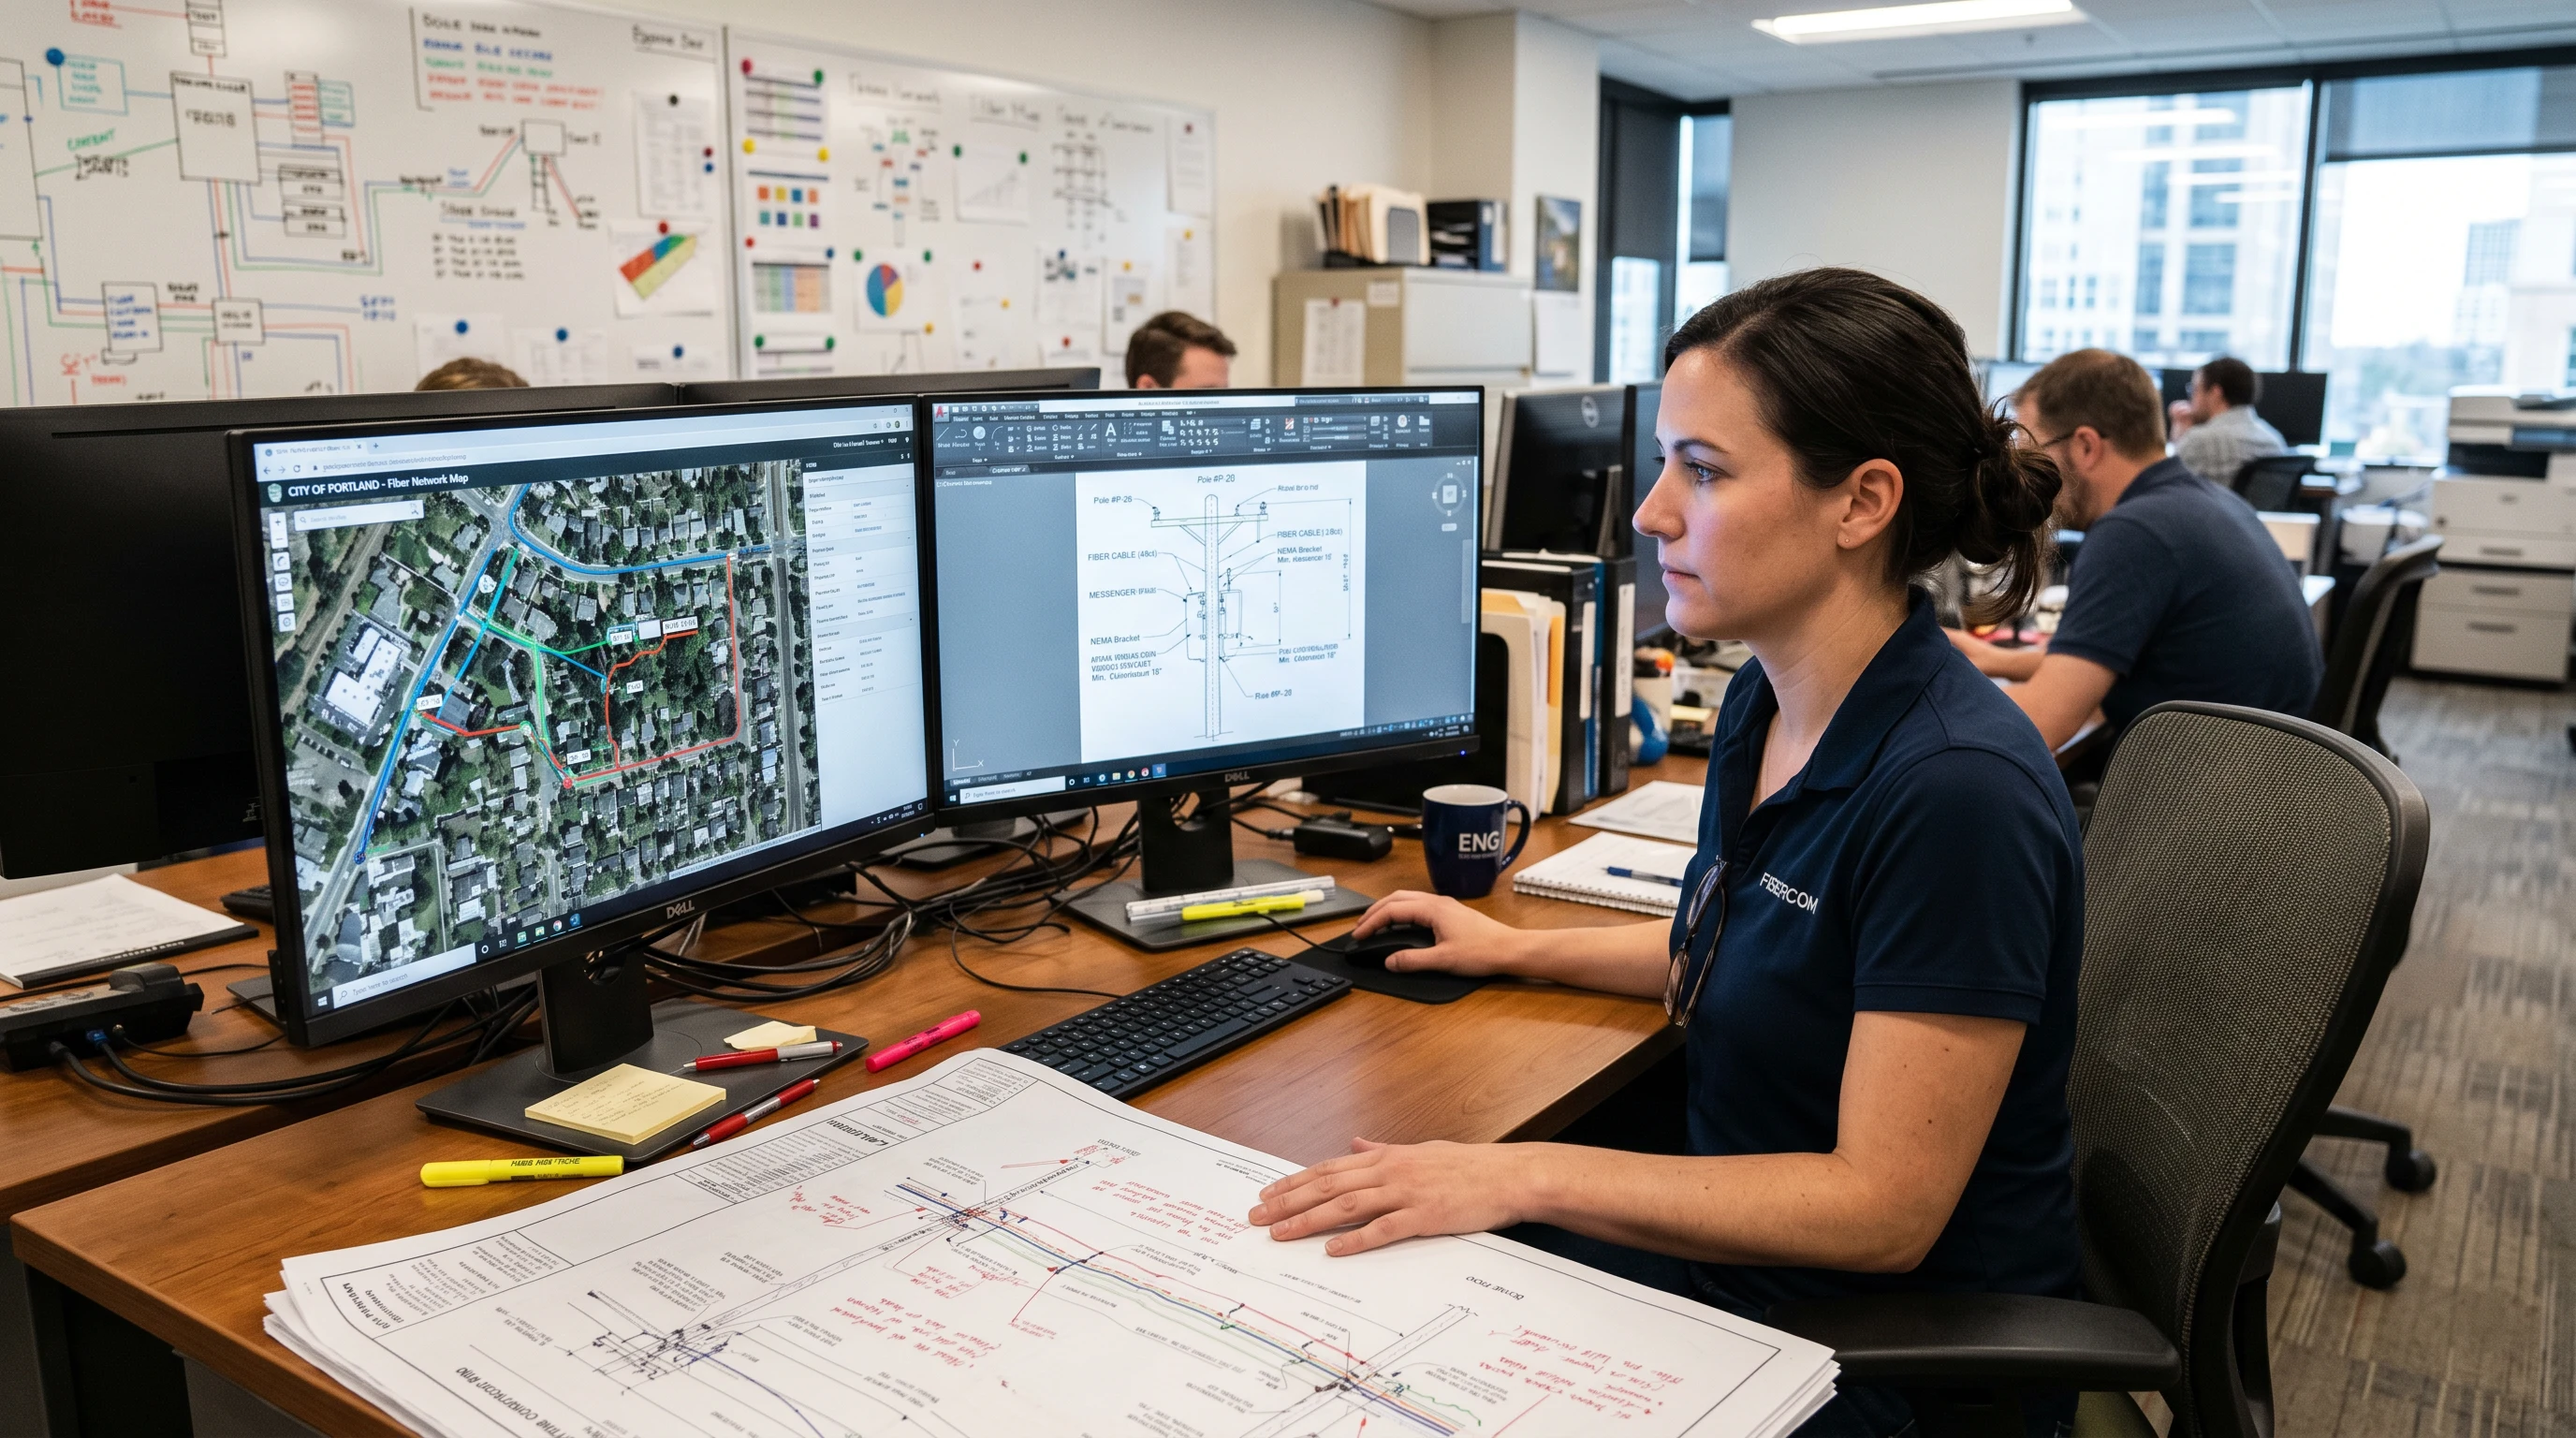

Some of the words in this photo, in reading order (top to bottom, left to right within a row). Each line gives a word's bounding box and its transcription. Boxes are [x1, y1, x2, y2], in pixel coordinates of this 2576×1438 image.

[287, 485, 310, 497] CITY
[311, 484, 326, 495] OF
[328, 479, 380, 493] PORTLAND
[387, 477, 410, 489] Fiber
[411, 474, 448, 487] Network
[449, 473, 469, 485] Map
[1197, 476, 1212, 484] Pole
[1093, 496, 1110, 505] Pole
[1088, 552, 1110, 561] FIBER
[1111, 550, 1136, 560] CABLE
[1277, 547, 1297, 555] NEMA
[1089, 588, 1136, 599] MESSENGER
[1090, 637, 1113, 645] NEMA
[1114, 634, 1140, 643] Bracket
[1091, 673, 1106, 682] Min.
[1458, 830, 1500, 852] ENG
[666, 900, 695, 919] DELL
